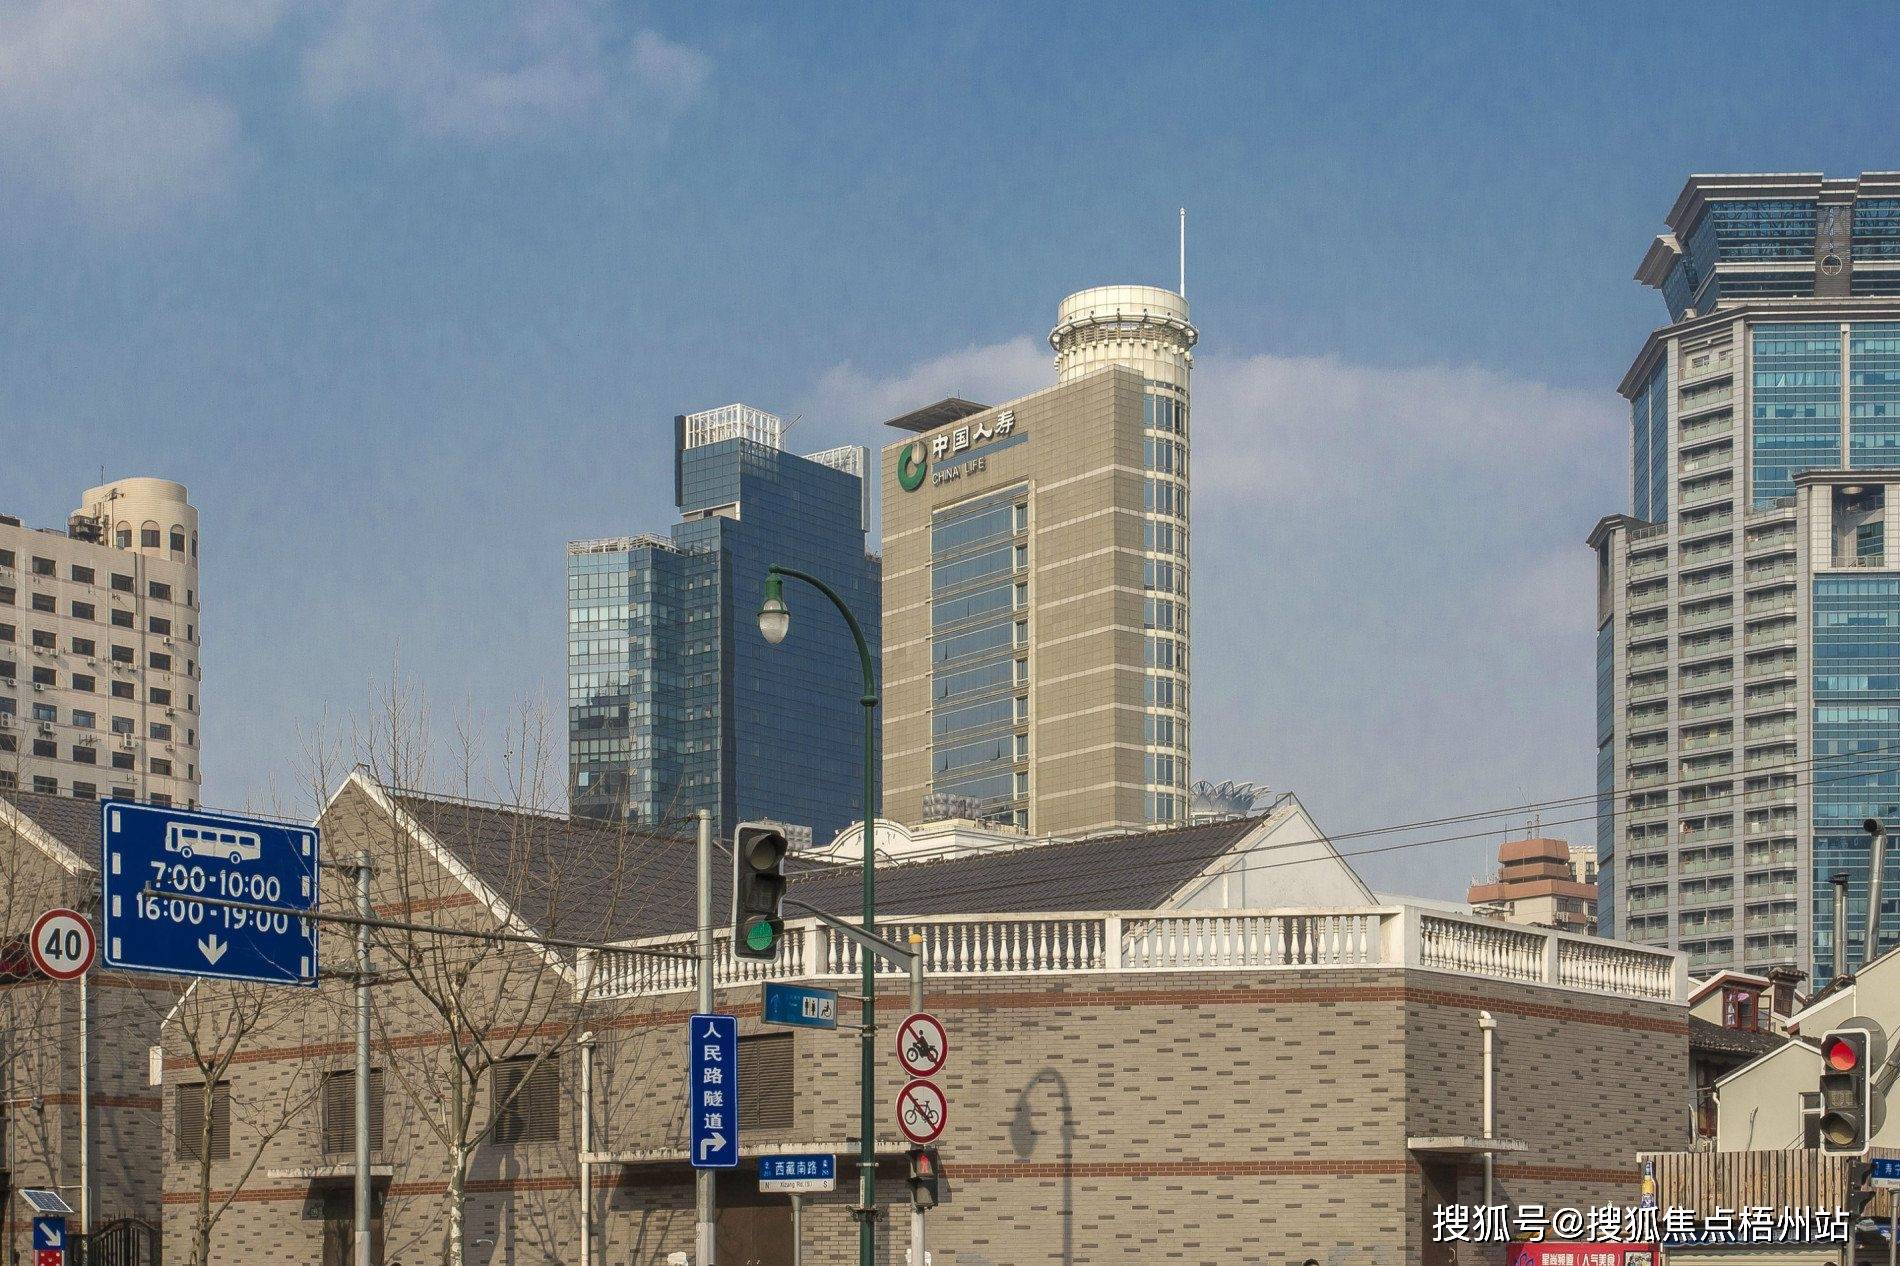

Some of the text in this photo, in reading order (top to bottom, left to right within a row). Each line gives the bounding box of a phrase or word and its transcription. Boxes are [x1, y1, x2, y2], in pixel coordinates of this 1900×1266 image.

[932, 410, 1015, 458] 中国人寿
[932, 457, 986, 486] CHINA LIFE
[150, 860, 281, 902] 7:00-10:00
[44, 928, 82, 961] 40
[703, 1021, 723, 1129] 人民路隧道
[775, 1160, 817, 1176] 西藏南路
[823, 1180, 828, 1189] S
